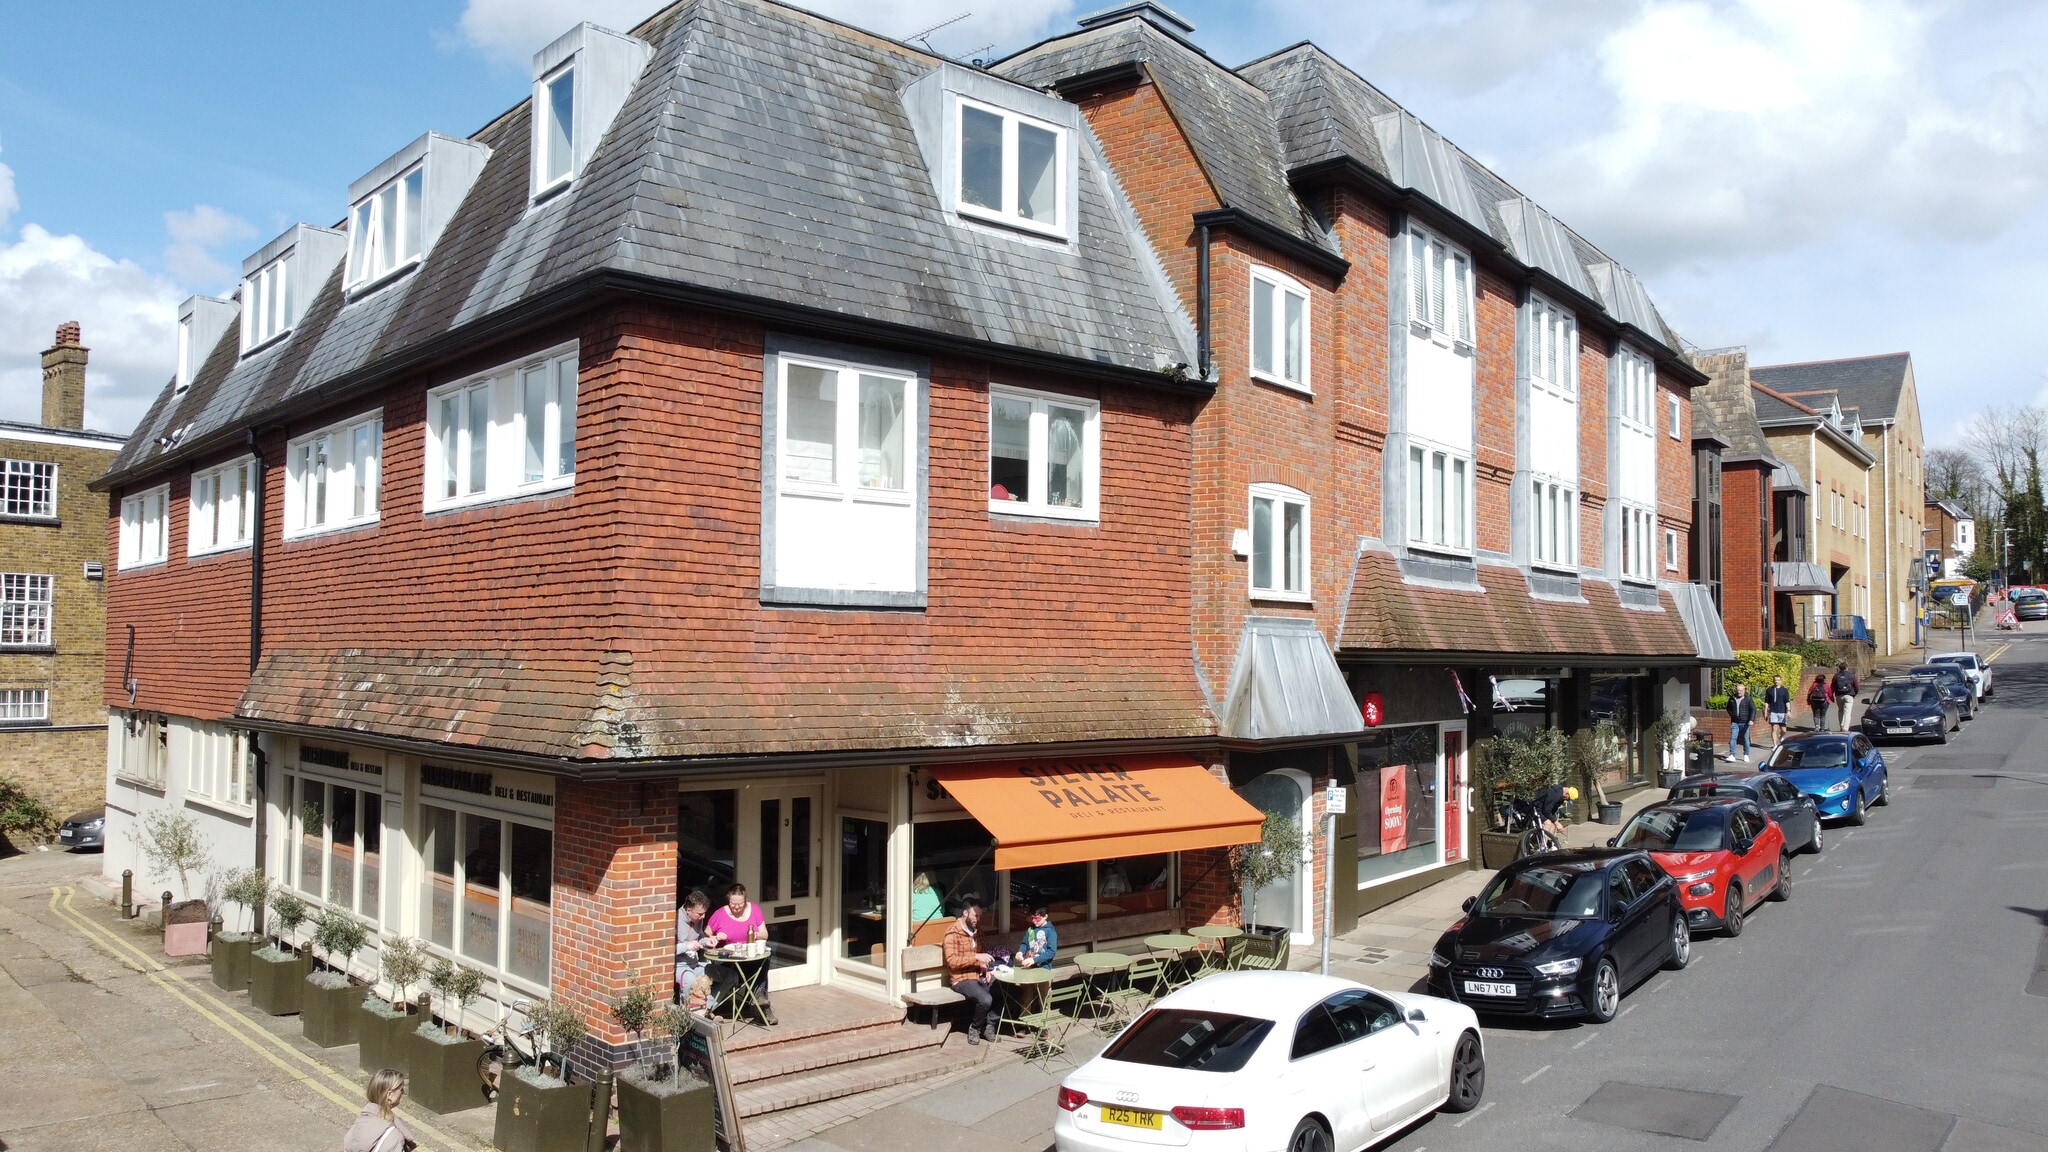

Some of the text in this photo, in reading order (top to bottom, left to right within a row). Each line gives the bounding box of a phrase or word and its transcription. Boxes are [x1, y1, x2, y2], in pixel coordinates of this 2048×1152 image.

[1018, 761, 1134, 787] SILVER
[495, 786, 507, 798] DELI
[509, 789, 514, 800] &
[1038, 783, 1161, 809] PALATE
[1069, 811, 1092, 819] DELI
[1110, 805, 1167, 815] RESTAURANT
[1384, 804, 1402, 817] Opening
[784, 818, 790, 827] 3
[1468, 982, 1512, 995] LN67 VSG
[1109, 1107, 1154, 1126] R25 TRK
